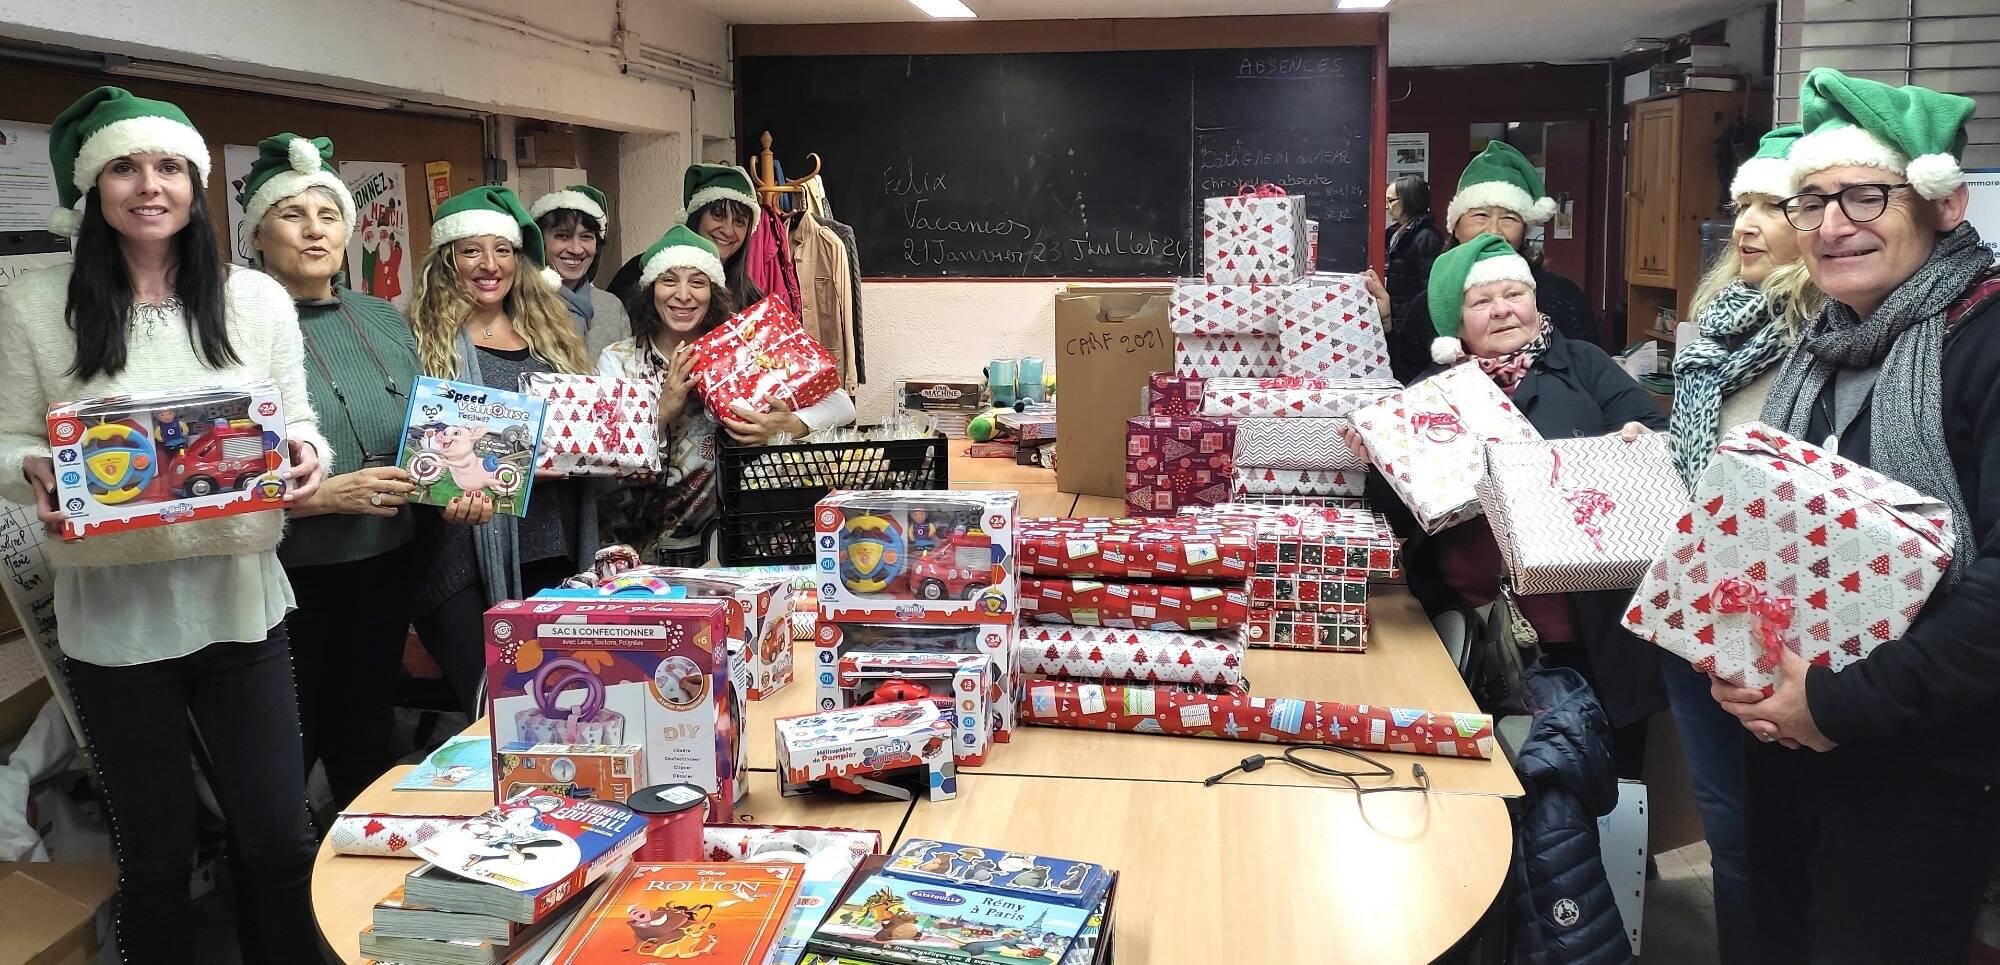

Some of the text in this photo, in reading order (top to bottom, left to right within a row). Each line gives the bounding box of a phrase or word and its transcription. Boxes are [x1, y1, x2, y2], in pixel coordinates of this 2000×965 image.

[1239, 58, 1344, 75] ABSENCES
[1278, 173, 1333, 187] absente
[352, 171, 388, 211] ONNEZ
[371, 202, 404, 230] MECI!
[904, 198, 1031, 239] Vacances
[1120, 328, 1164, 353] 2021
[447, 389, 488, 404] Speed
[170, 504, 193, 513] Baby
[904, 605, 924, 613] Baby
[552, 627, 571, 636] SAC
[578, 627, 655, 637] CONFECTIONNER
[664, 724, 701, 741] DIY
[817, 746, 853, 756] Hélicoptère
[877, 740, 911, 755] Baby
[573, 801, 633, 822] SAYONARA
[550, 808, 627, 833] FOOTBALL
[645, 881, 760, 892] ROI LION
[911, 891, 962, 903] RATATOUILLE
[983, 897, 1025, 912] Rémy
[971, 906, 1025, 921] à Paris
